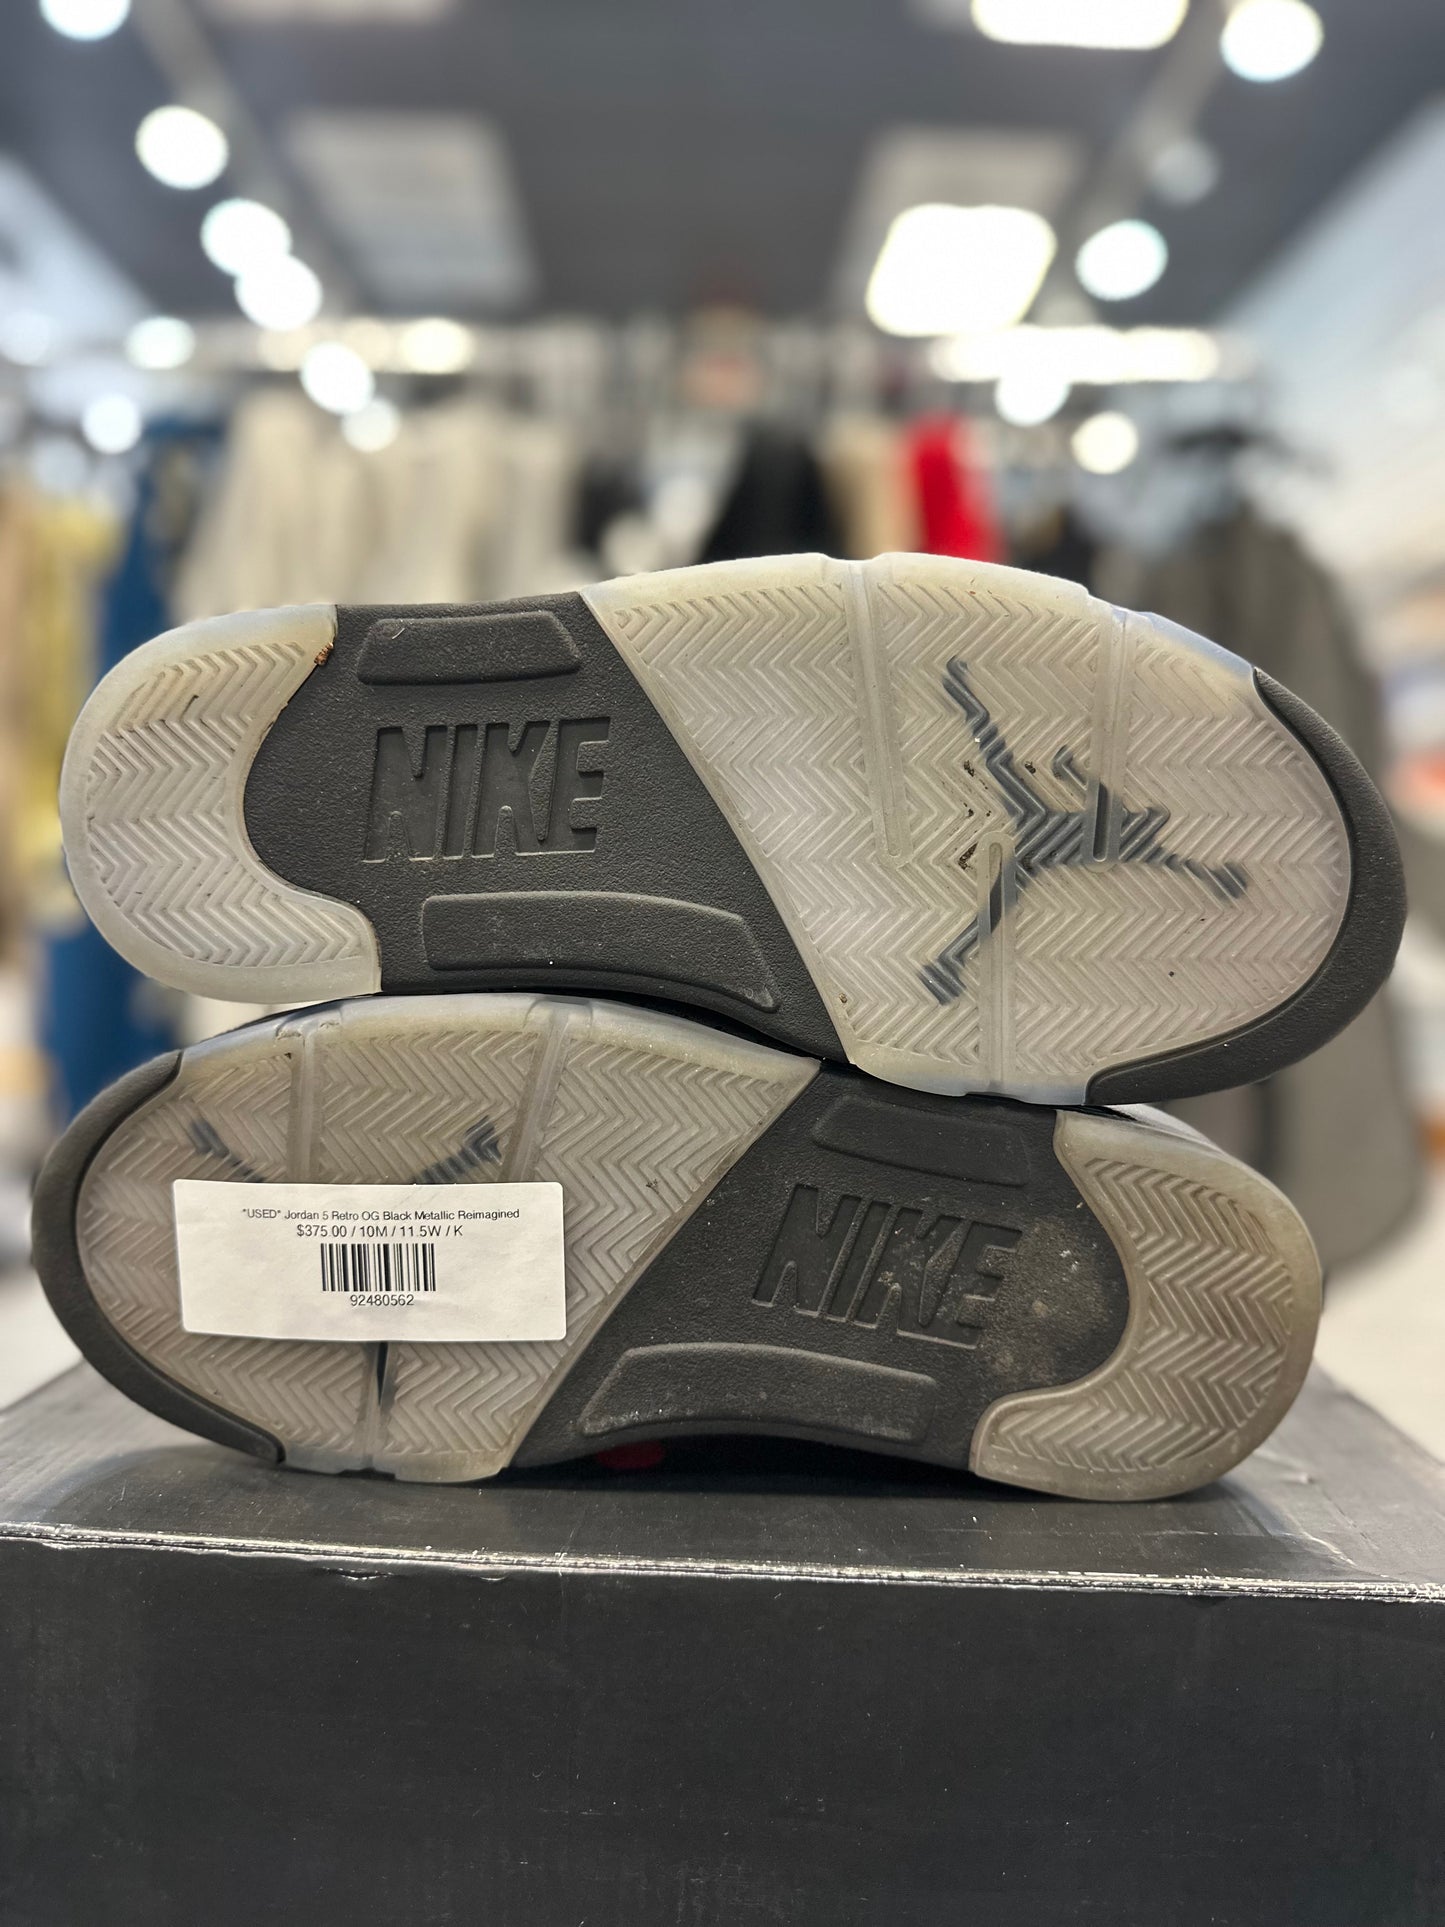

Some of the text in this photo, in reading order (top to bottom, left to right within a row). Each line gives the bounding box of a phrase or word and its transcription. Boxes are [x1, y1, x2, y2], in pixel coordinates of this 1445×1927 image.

[361, 716, 611, 864] NIKE
[284, 1210, 320, 1220] Jordan
[322, 1211, 329, 1220] 5
[331, 1211, 359, 1220] Retro
[361, 1211, 380, 1221] OG
[383, 1210, 412, 1220] Black
[414, 1210, 455, 1220] Metallic
[458, 1209, 520, 1221] Reimagined
[296, 1224, 463, 1237] $375.00 / 10M / 11.5W / K
[751, 1183, 1022, 1349] NIKE
[349, 1294, 415, 1306] 92480562
